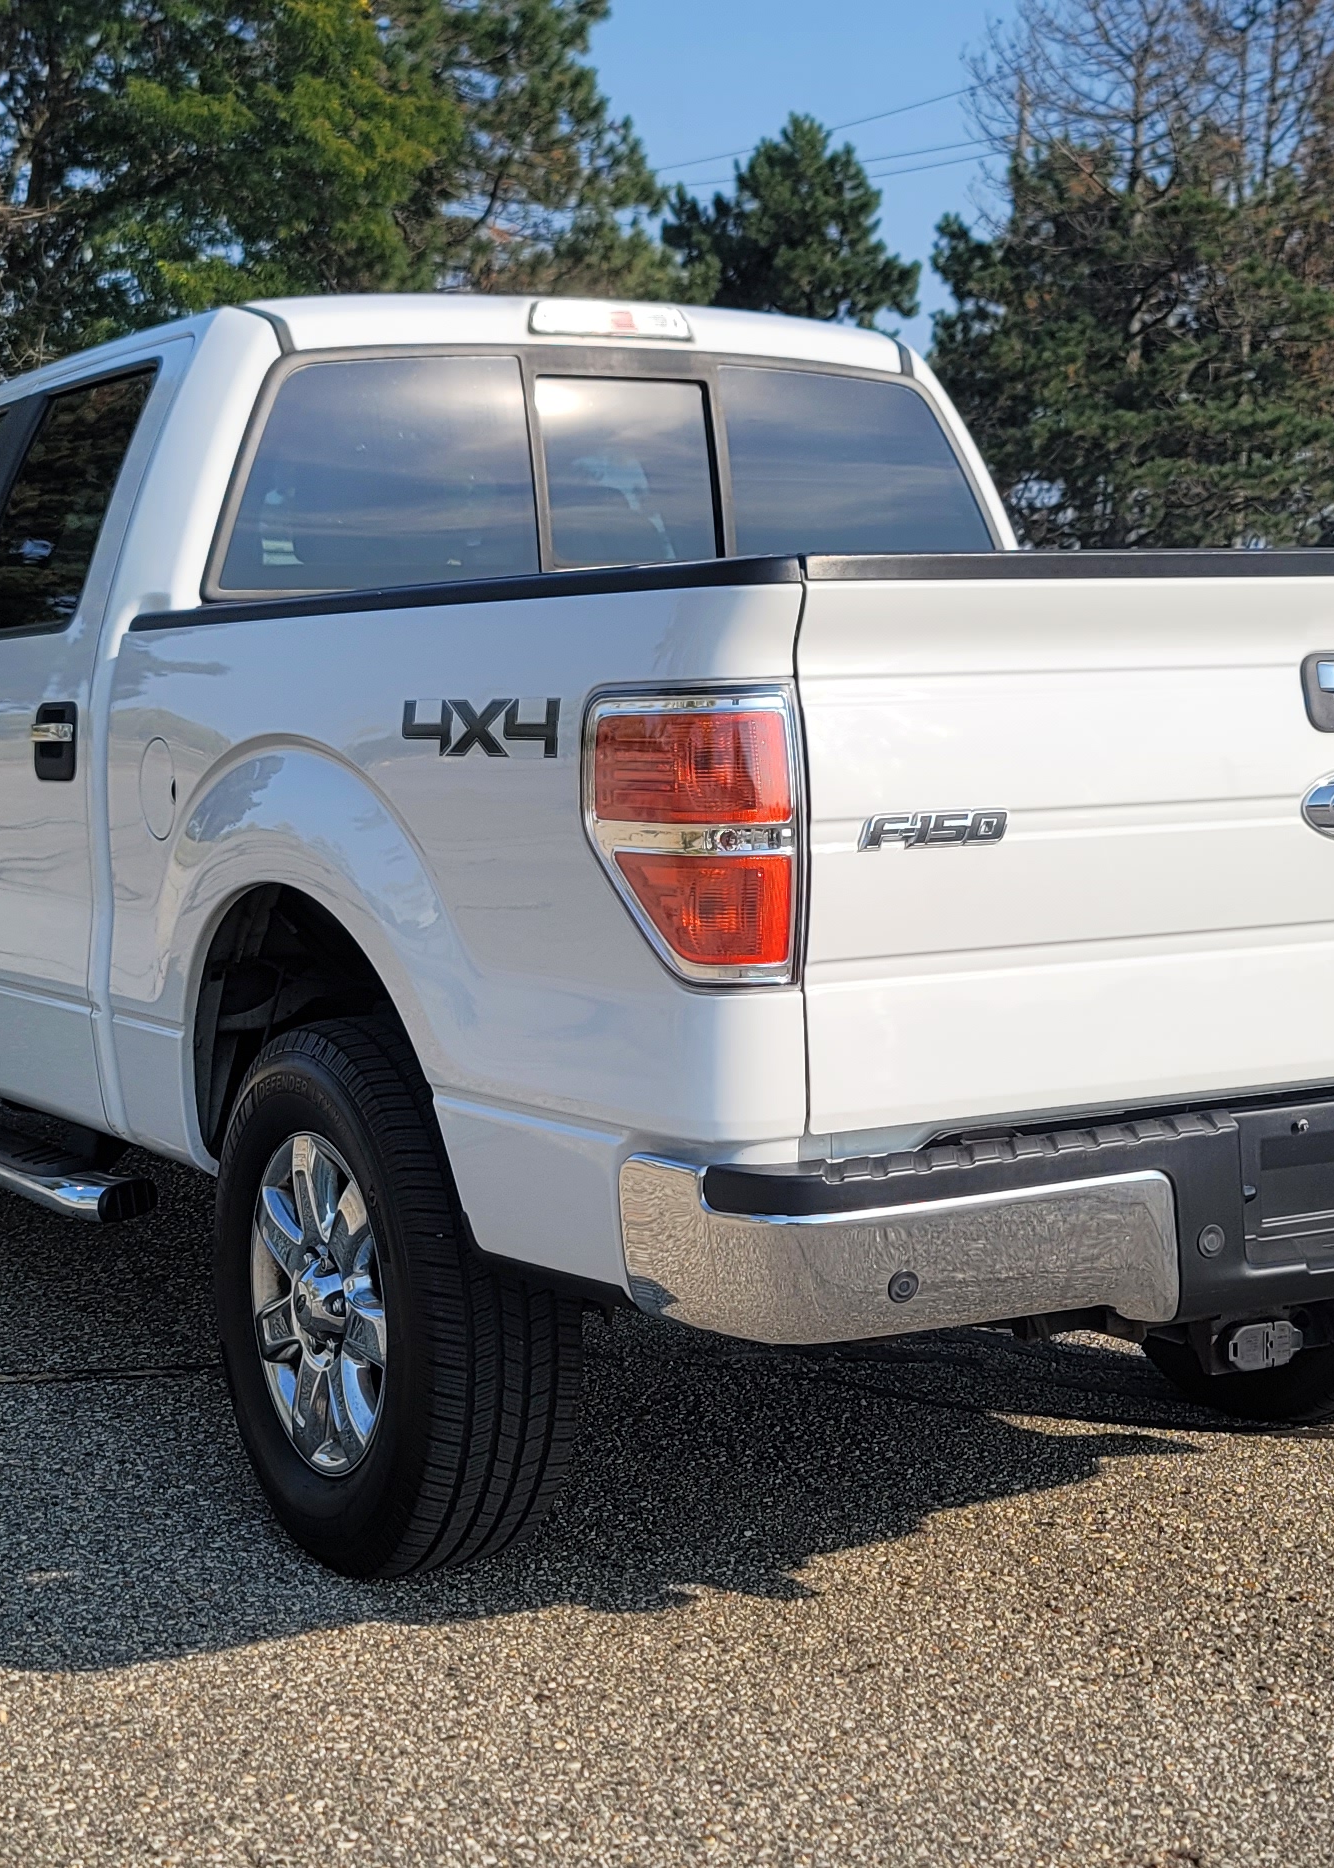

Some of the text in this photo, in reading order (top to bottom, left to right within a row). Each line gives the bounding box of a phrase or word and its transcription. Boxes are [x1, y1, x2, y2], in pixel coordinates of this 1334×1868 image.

[401, 698, 561, 758] 4X4
[857, 806, 1010, 852] F-150
[258, 1074, 308, 1099] DEFENDER
